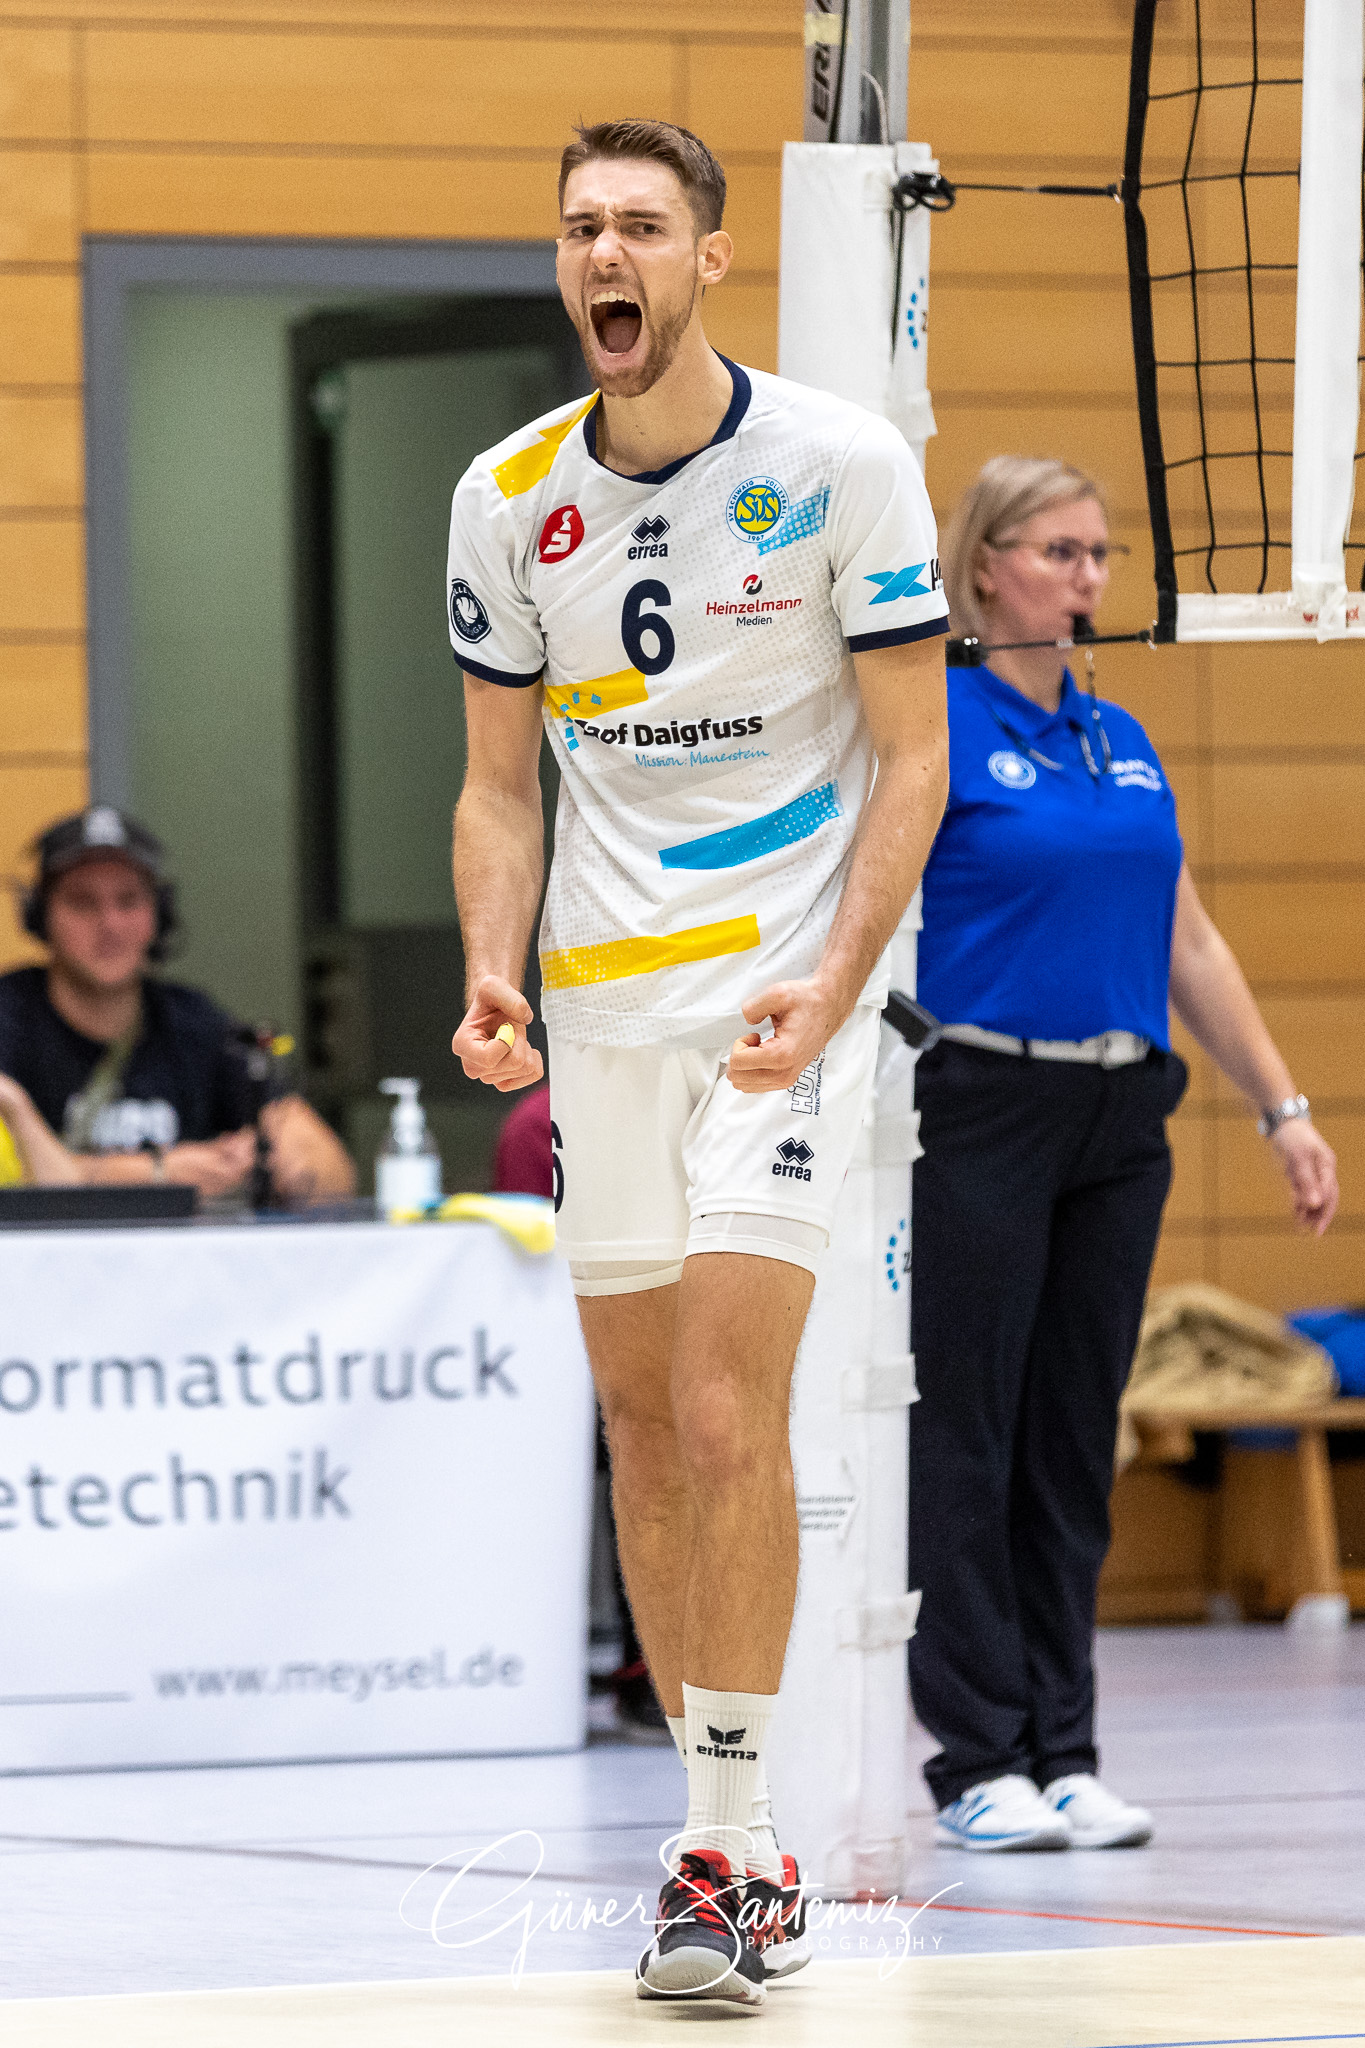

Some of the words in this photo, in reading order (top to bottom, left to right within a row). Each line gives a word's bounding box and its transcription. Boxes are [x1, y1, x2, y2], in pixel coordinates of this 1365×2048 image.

[627, 543, 669, 560] errea
[706, 598, 803, 616] Heinzelmann
[621, 578, 676, 676] 6
[736, 615, 773, 627] Medien
[633, 715, 764, 748] Daigfuss
[635, 753, 688, 768] Mission:
[689, 747, 770, 768] Mauerstein
[772, 1162, 812, 1182] errea
[0, 1325, 519, 1414] ormatdruck
[150, 1643, 524, 1702] www.meysel.de
[696, 1744, 758, 1761] erima
